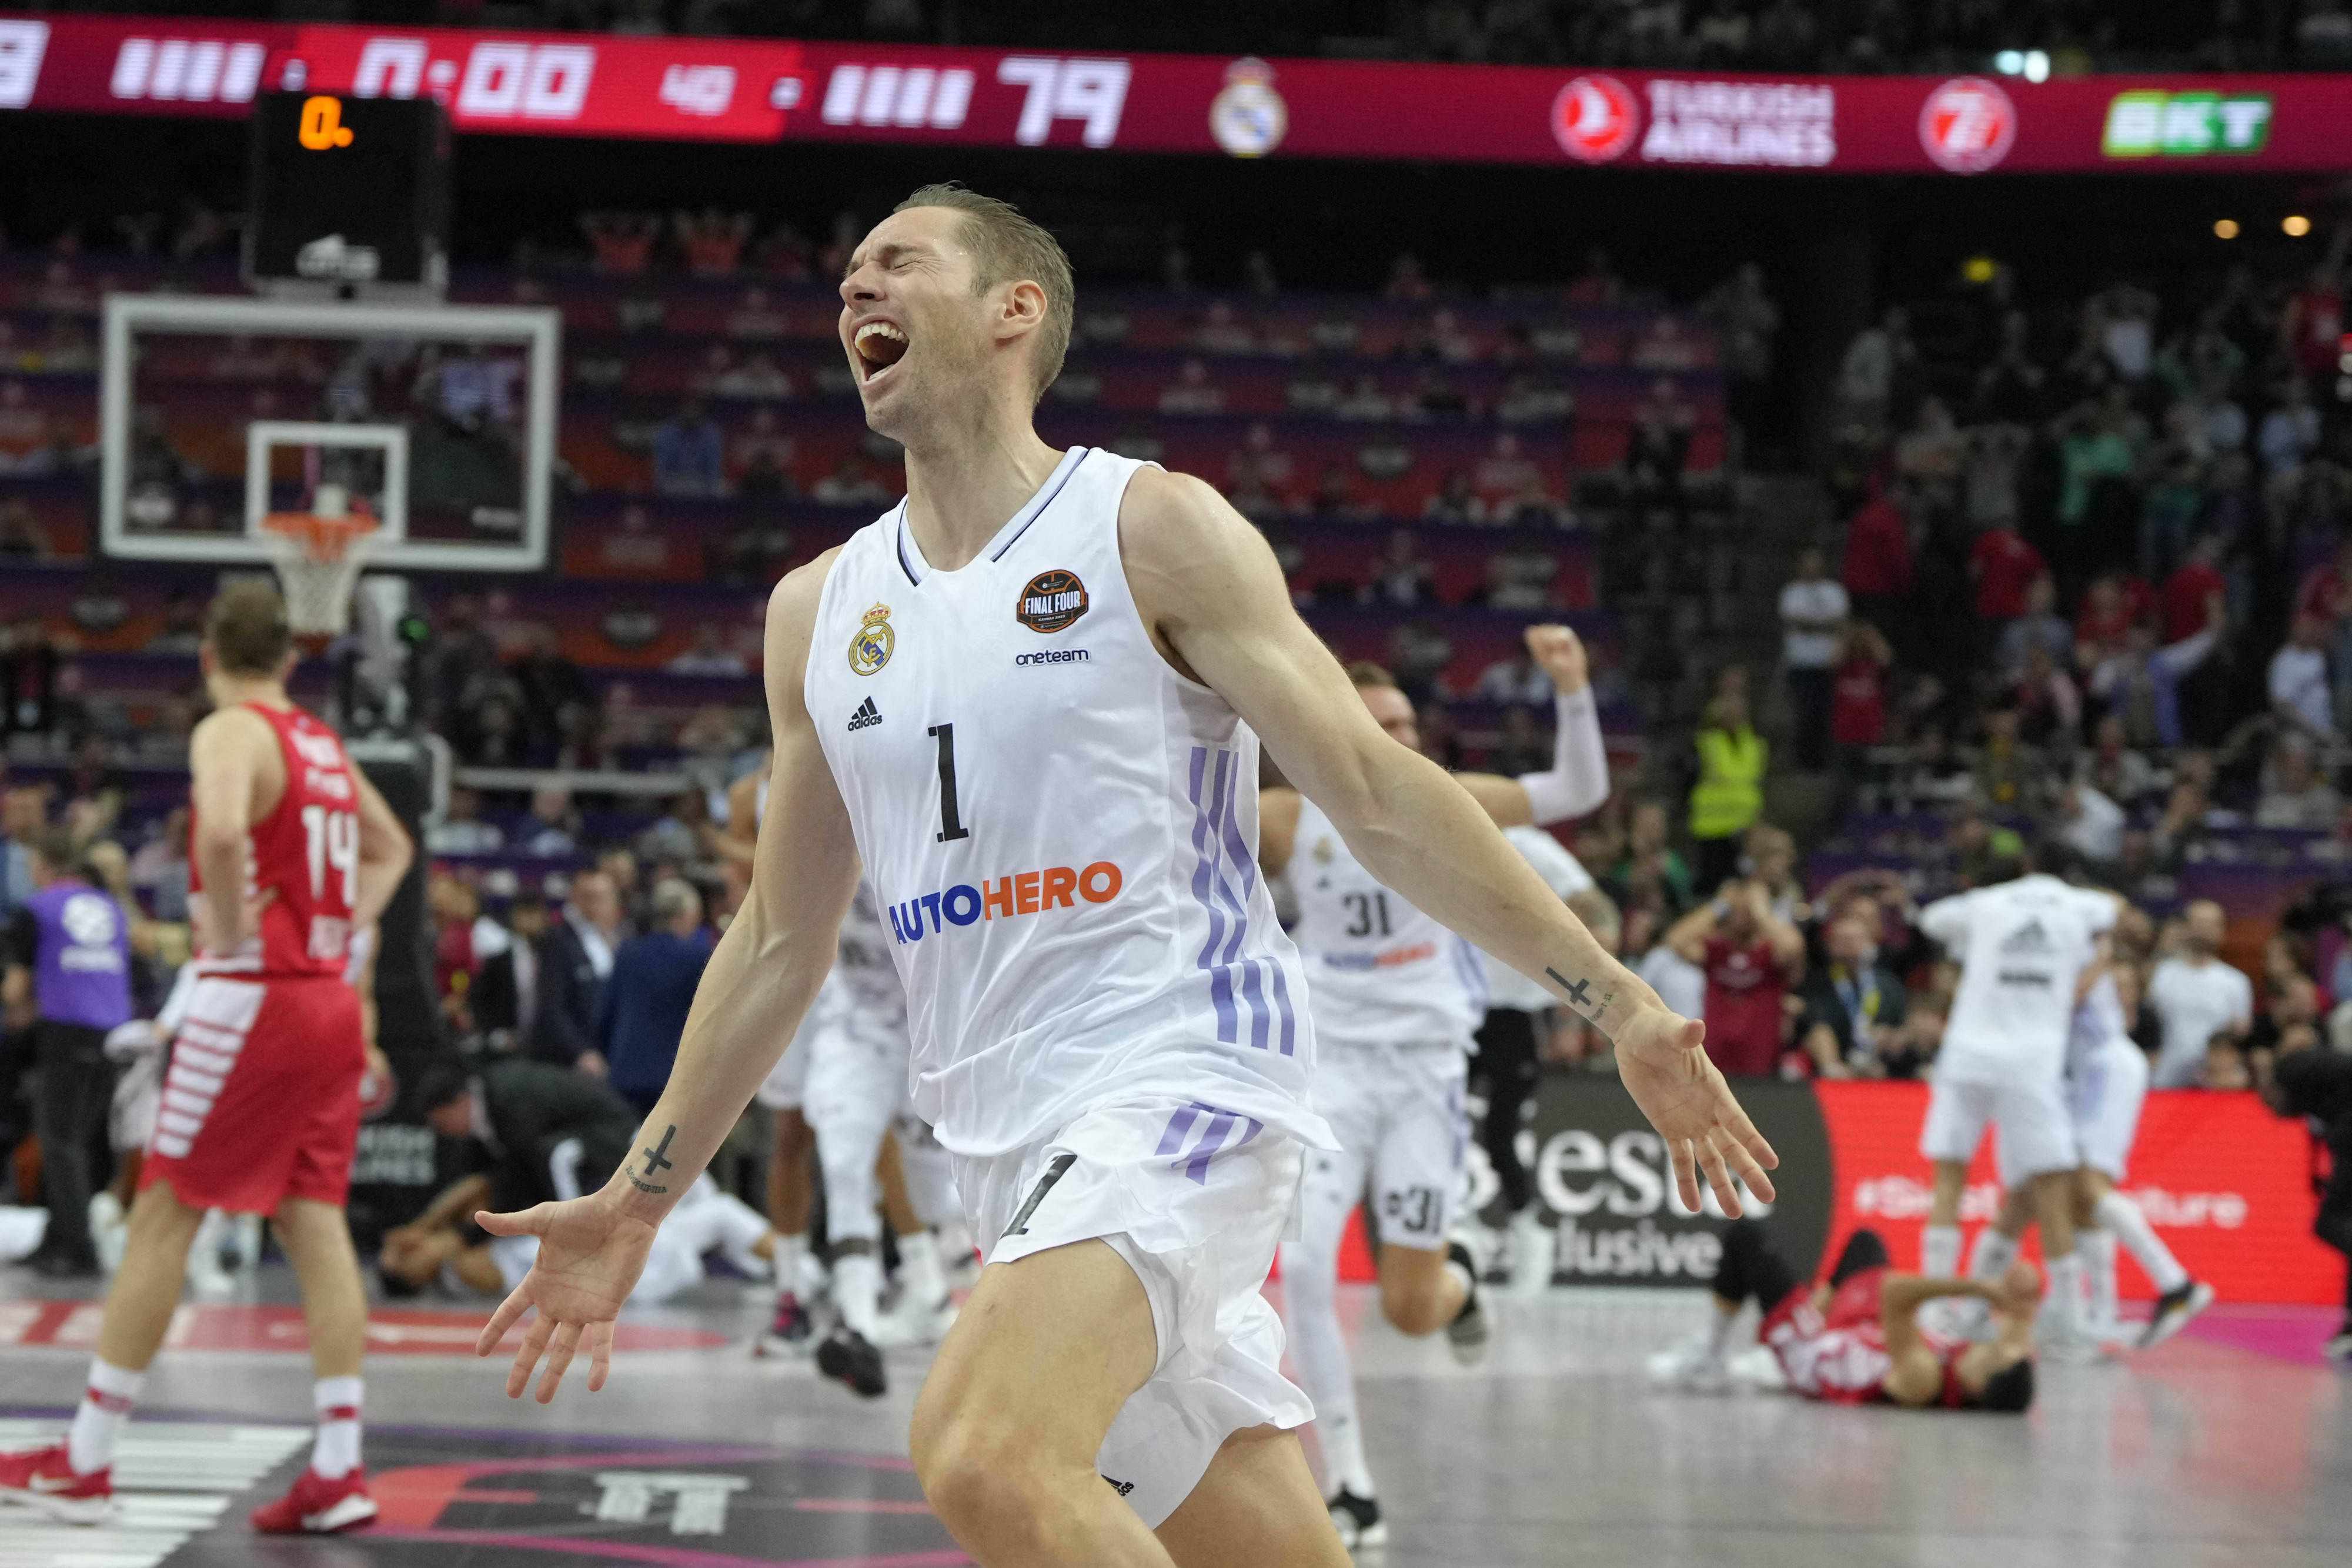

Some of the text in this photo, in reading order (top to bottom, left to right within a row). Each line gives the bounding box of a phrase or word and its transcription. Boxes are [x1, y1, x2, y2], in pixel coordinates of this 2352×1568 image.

[997, 55, 1132, 148] 79
[1646, 79, 1834, 119] TURKISH
[1641, 119, 1837, 166] AIRLINES
[1025, 590, 1081, 614] FINAL FOUR
[1016, 650, 1089, 666] oneteam
[848, 714, 883, 731] adidas
[928, 723, 969, 842] 1
[301, 804, 360, 909] 14
[888, 861, 1122, 945] AUTOHERO
[1342, 890, 1393, 937] 31
[999, 1154, 1078, 1241] 1
[1404, 1186, 1444, 1236] 31
